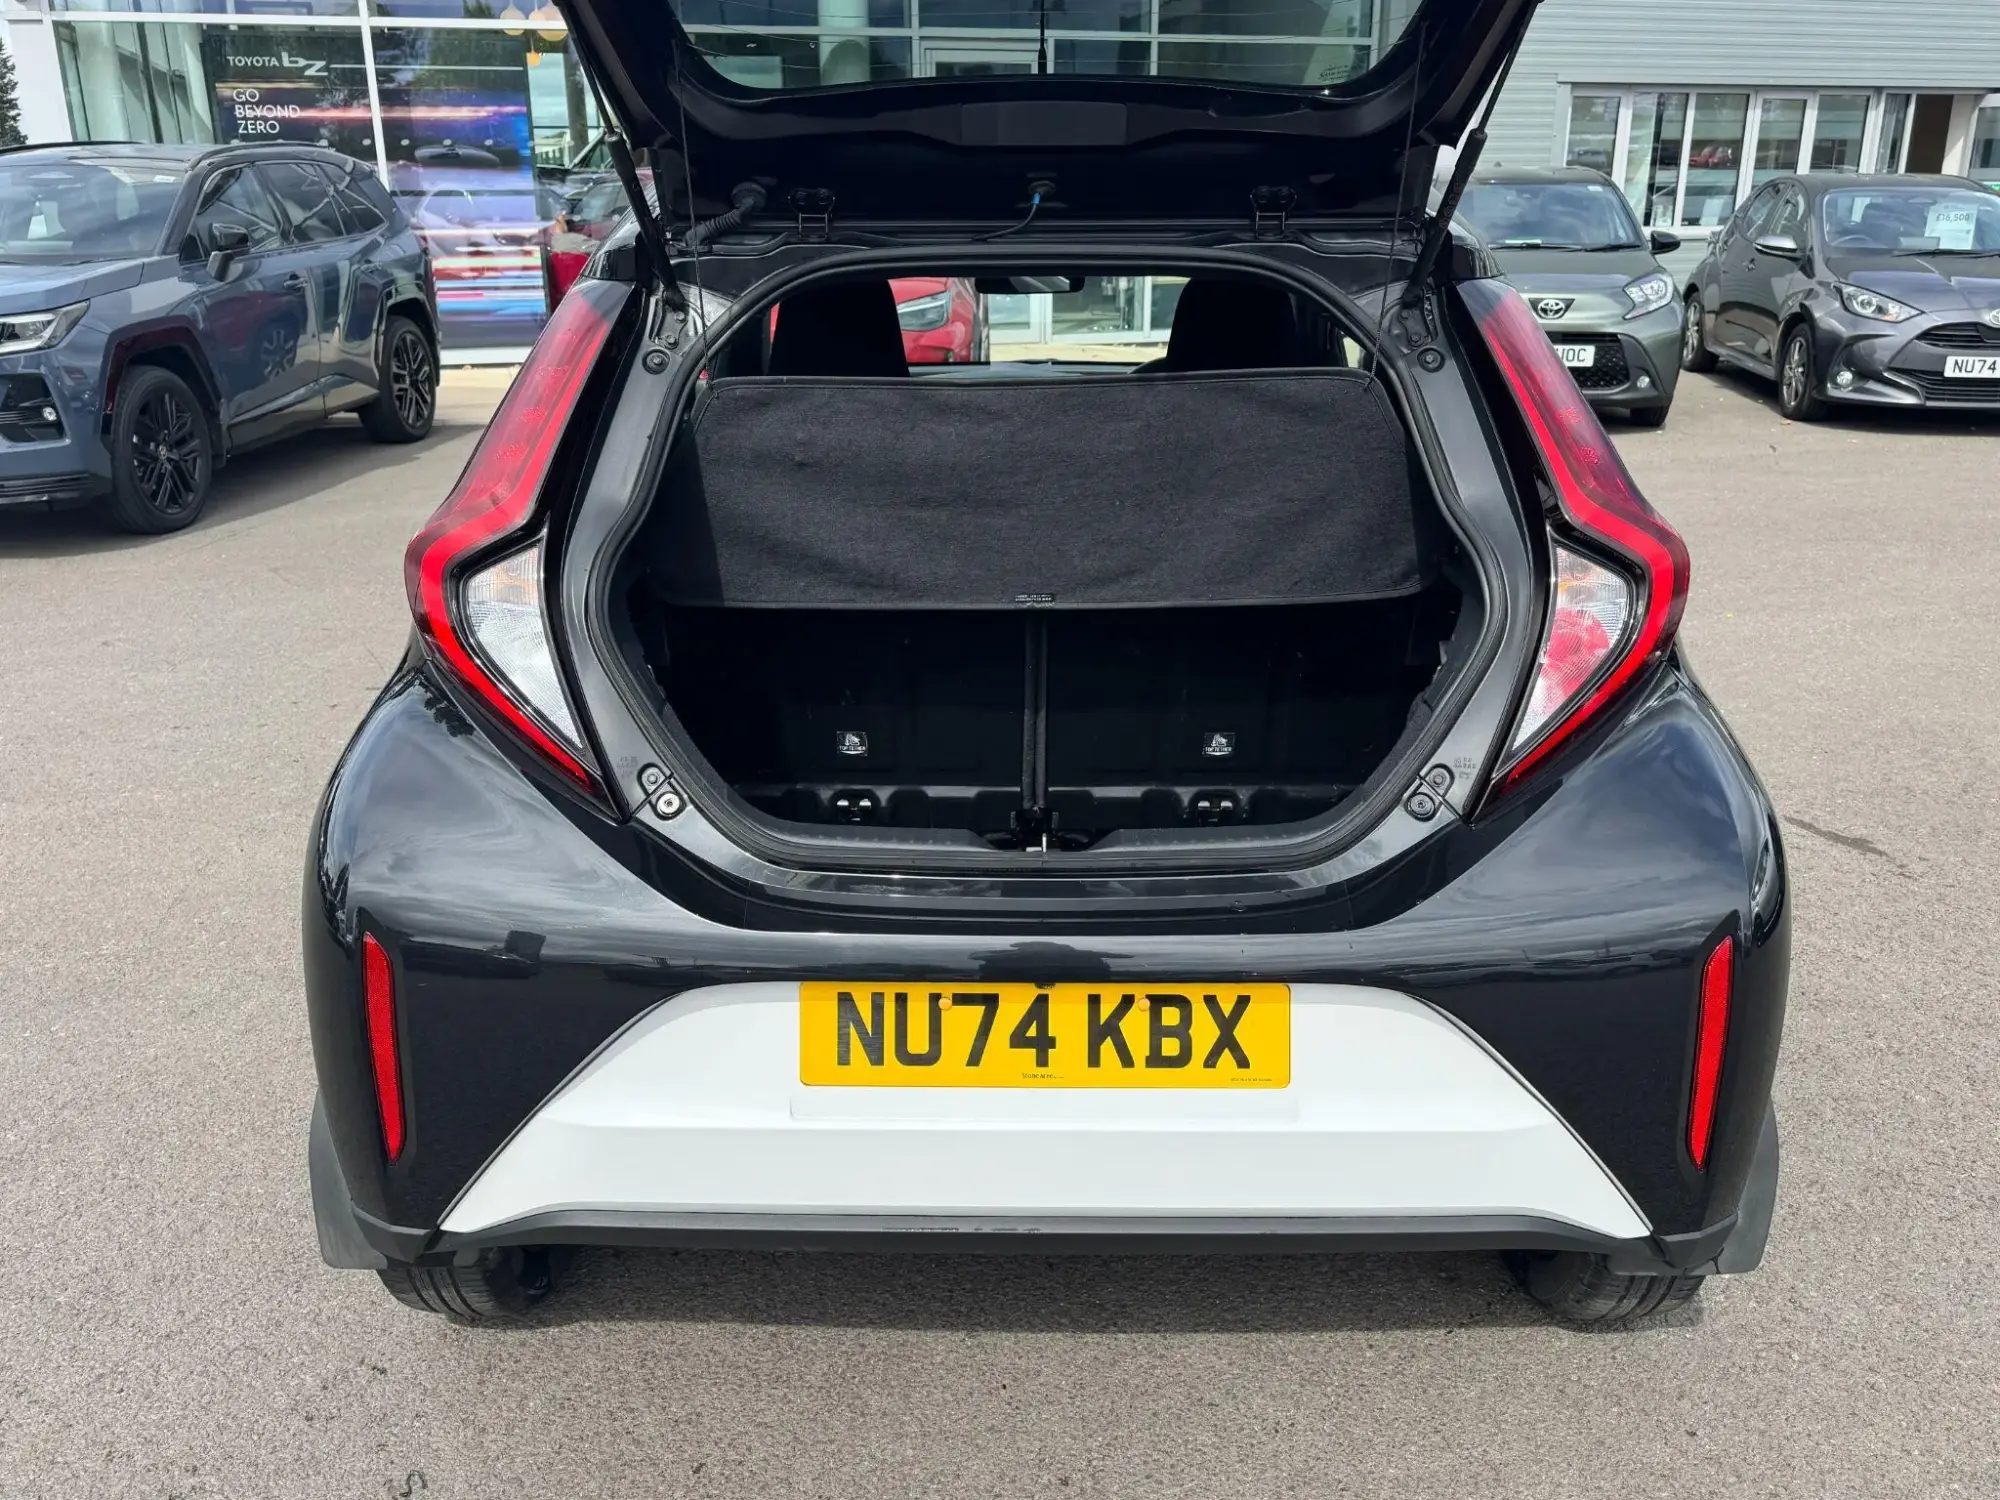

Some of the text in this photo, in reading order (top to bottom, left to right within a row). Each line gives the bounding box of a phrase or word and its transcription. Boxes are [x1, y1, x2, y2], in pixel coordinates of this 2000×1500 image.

[226, 55, 280, 67] TOYOTA
[232, 88, 260, 102] GO
[234, 104, 301, 118] BEYOND
[237, 120, 280, 133] ZERO
[1936, 213, 1970, 222] £16,500
[1952, 359, 1997, 374] NU74
[836, 991, 1252, 1069] NU74 KBX
